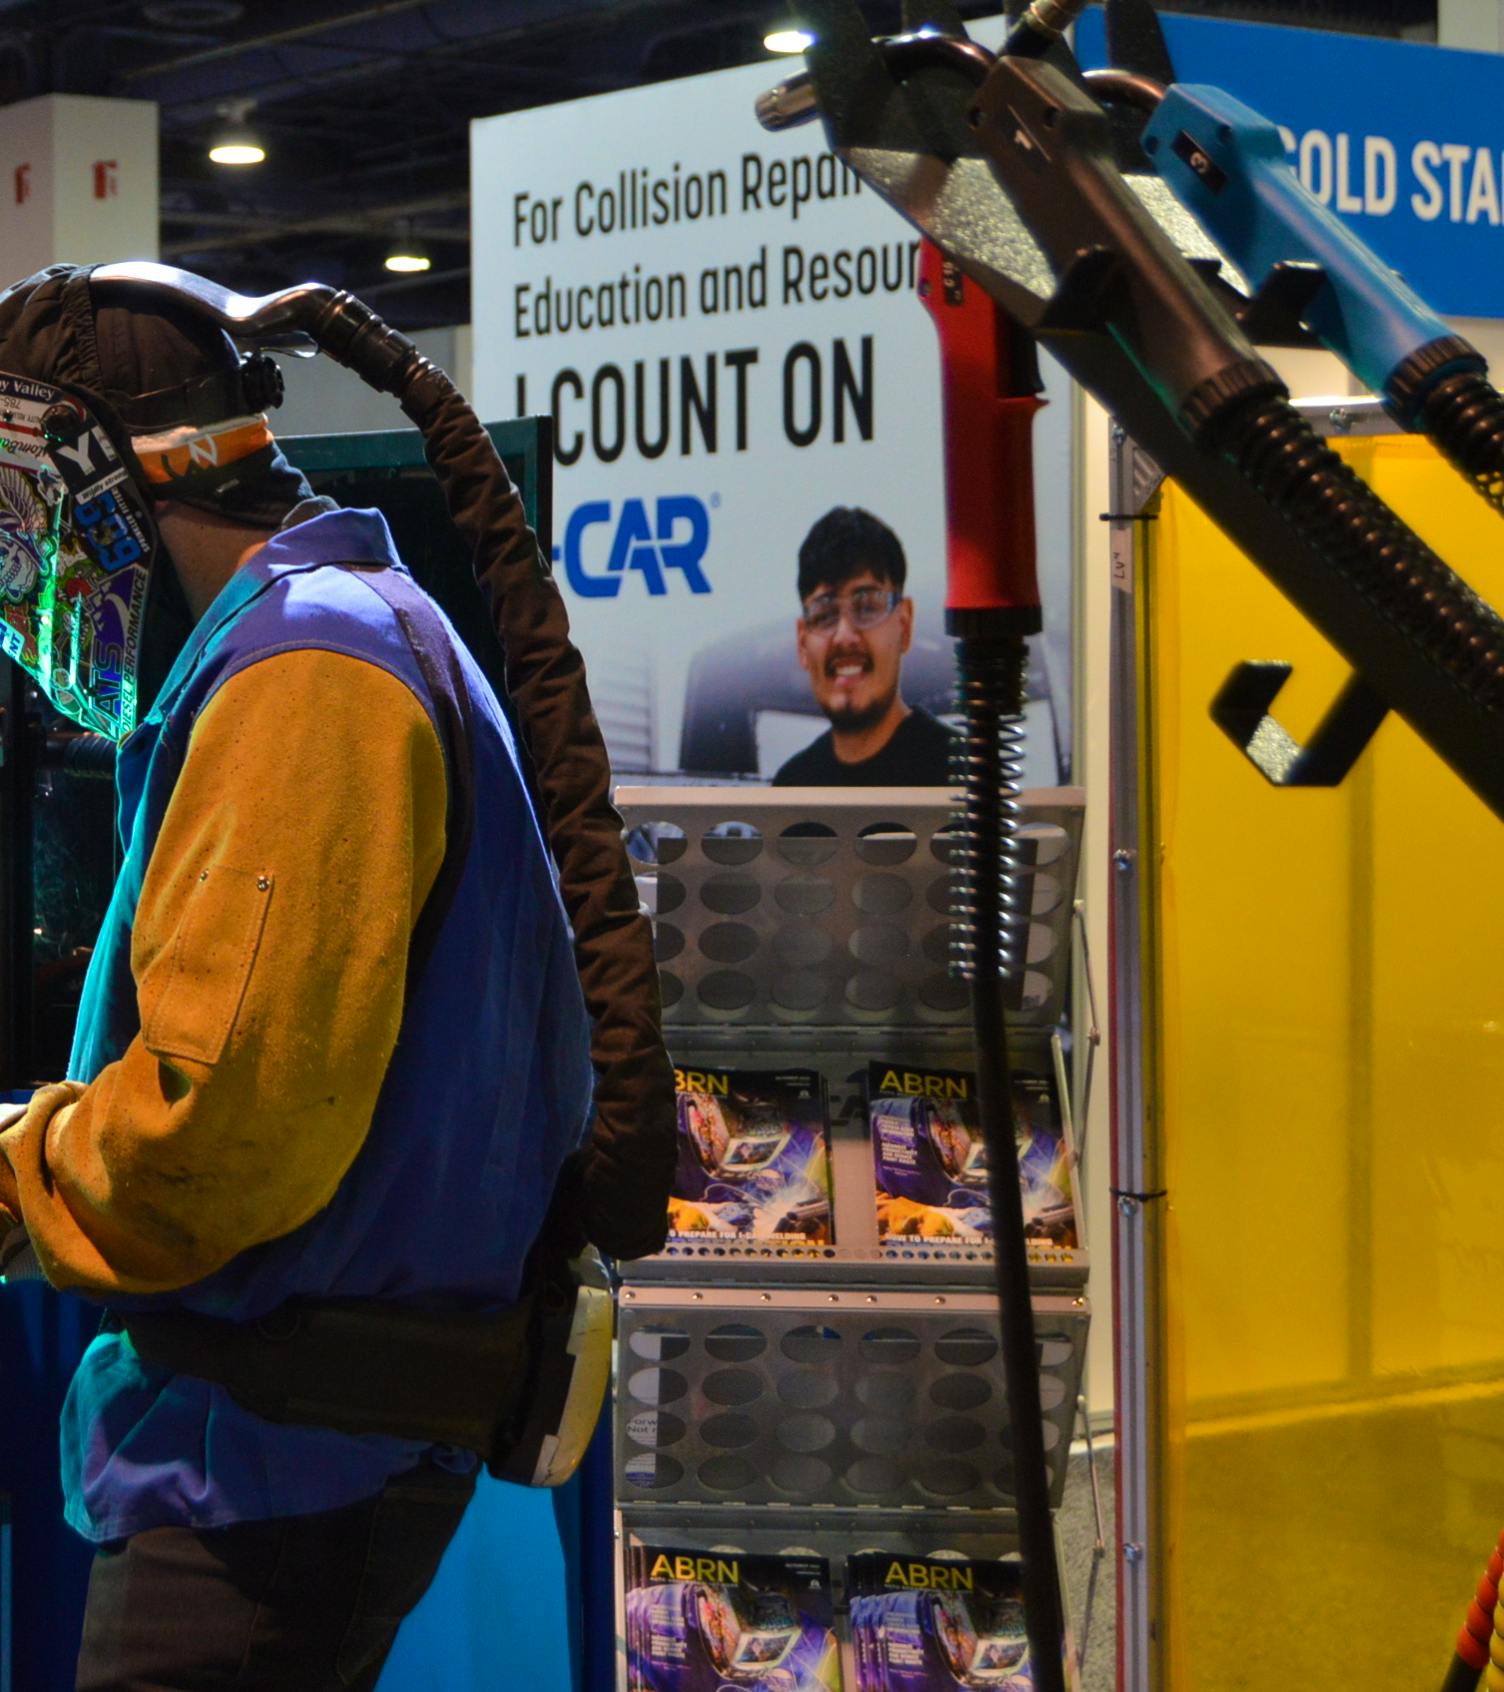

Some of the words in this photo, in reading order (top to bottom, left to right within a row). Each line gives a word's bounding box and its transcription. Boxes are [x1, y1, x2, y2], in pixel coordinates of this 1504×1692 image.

[514, 192, 563, 246] For
[574, 162, 727, 237] Collision
[1410, 140, 1504, 227] STA
[514, 263, 686, 338] Education
[699, 244, 767, 315] and
[13, 381, 56, 400] Valley
[551, 347, 759, 466] COUNT
[783, 334, 874, 447] ON
[123, 569, 146, 683] PERFORMANCE
[94, 640, 123, 722] ATS
[121, 682, 135, 733] DIESEL
[673, 1068, 730, 1096] BRN
[879, 1069, 969, 1100] ABRN
[650, 1553, 740, 1585] ABRN
[884, 1560, 974, 1591] ABRN
